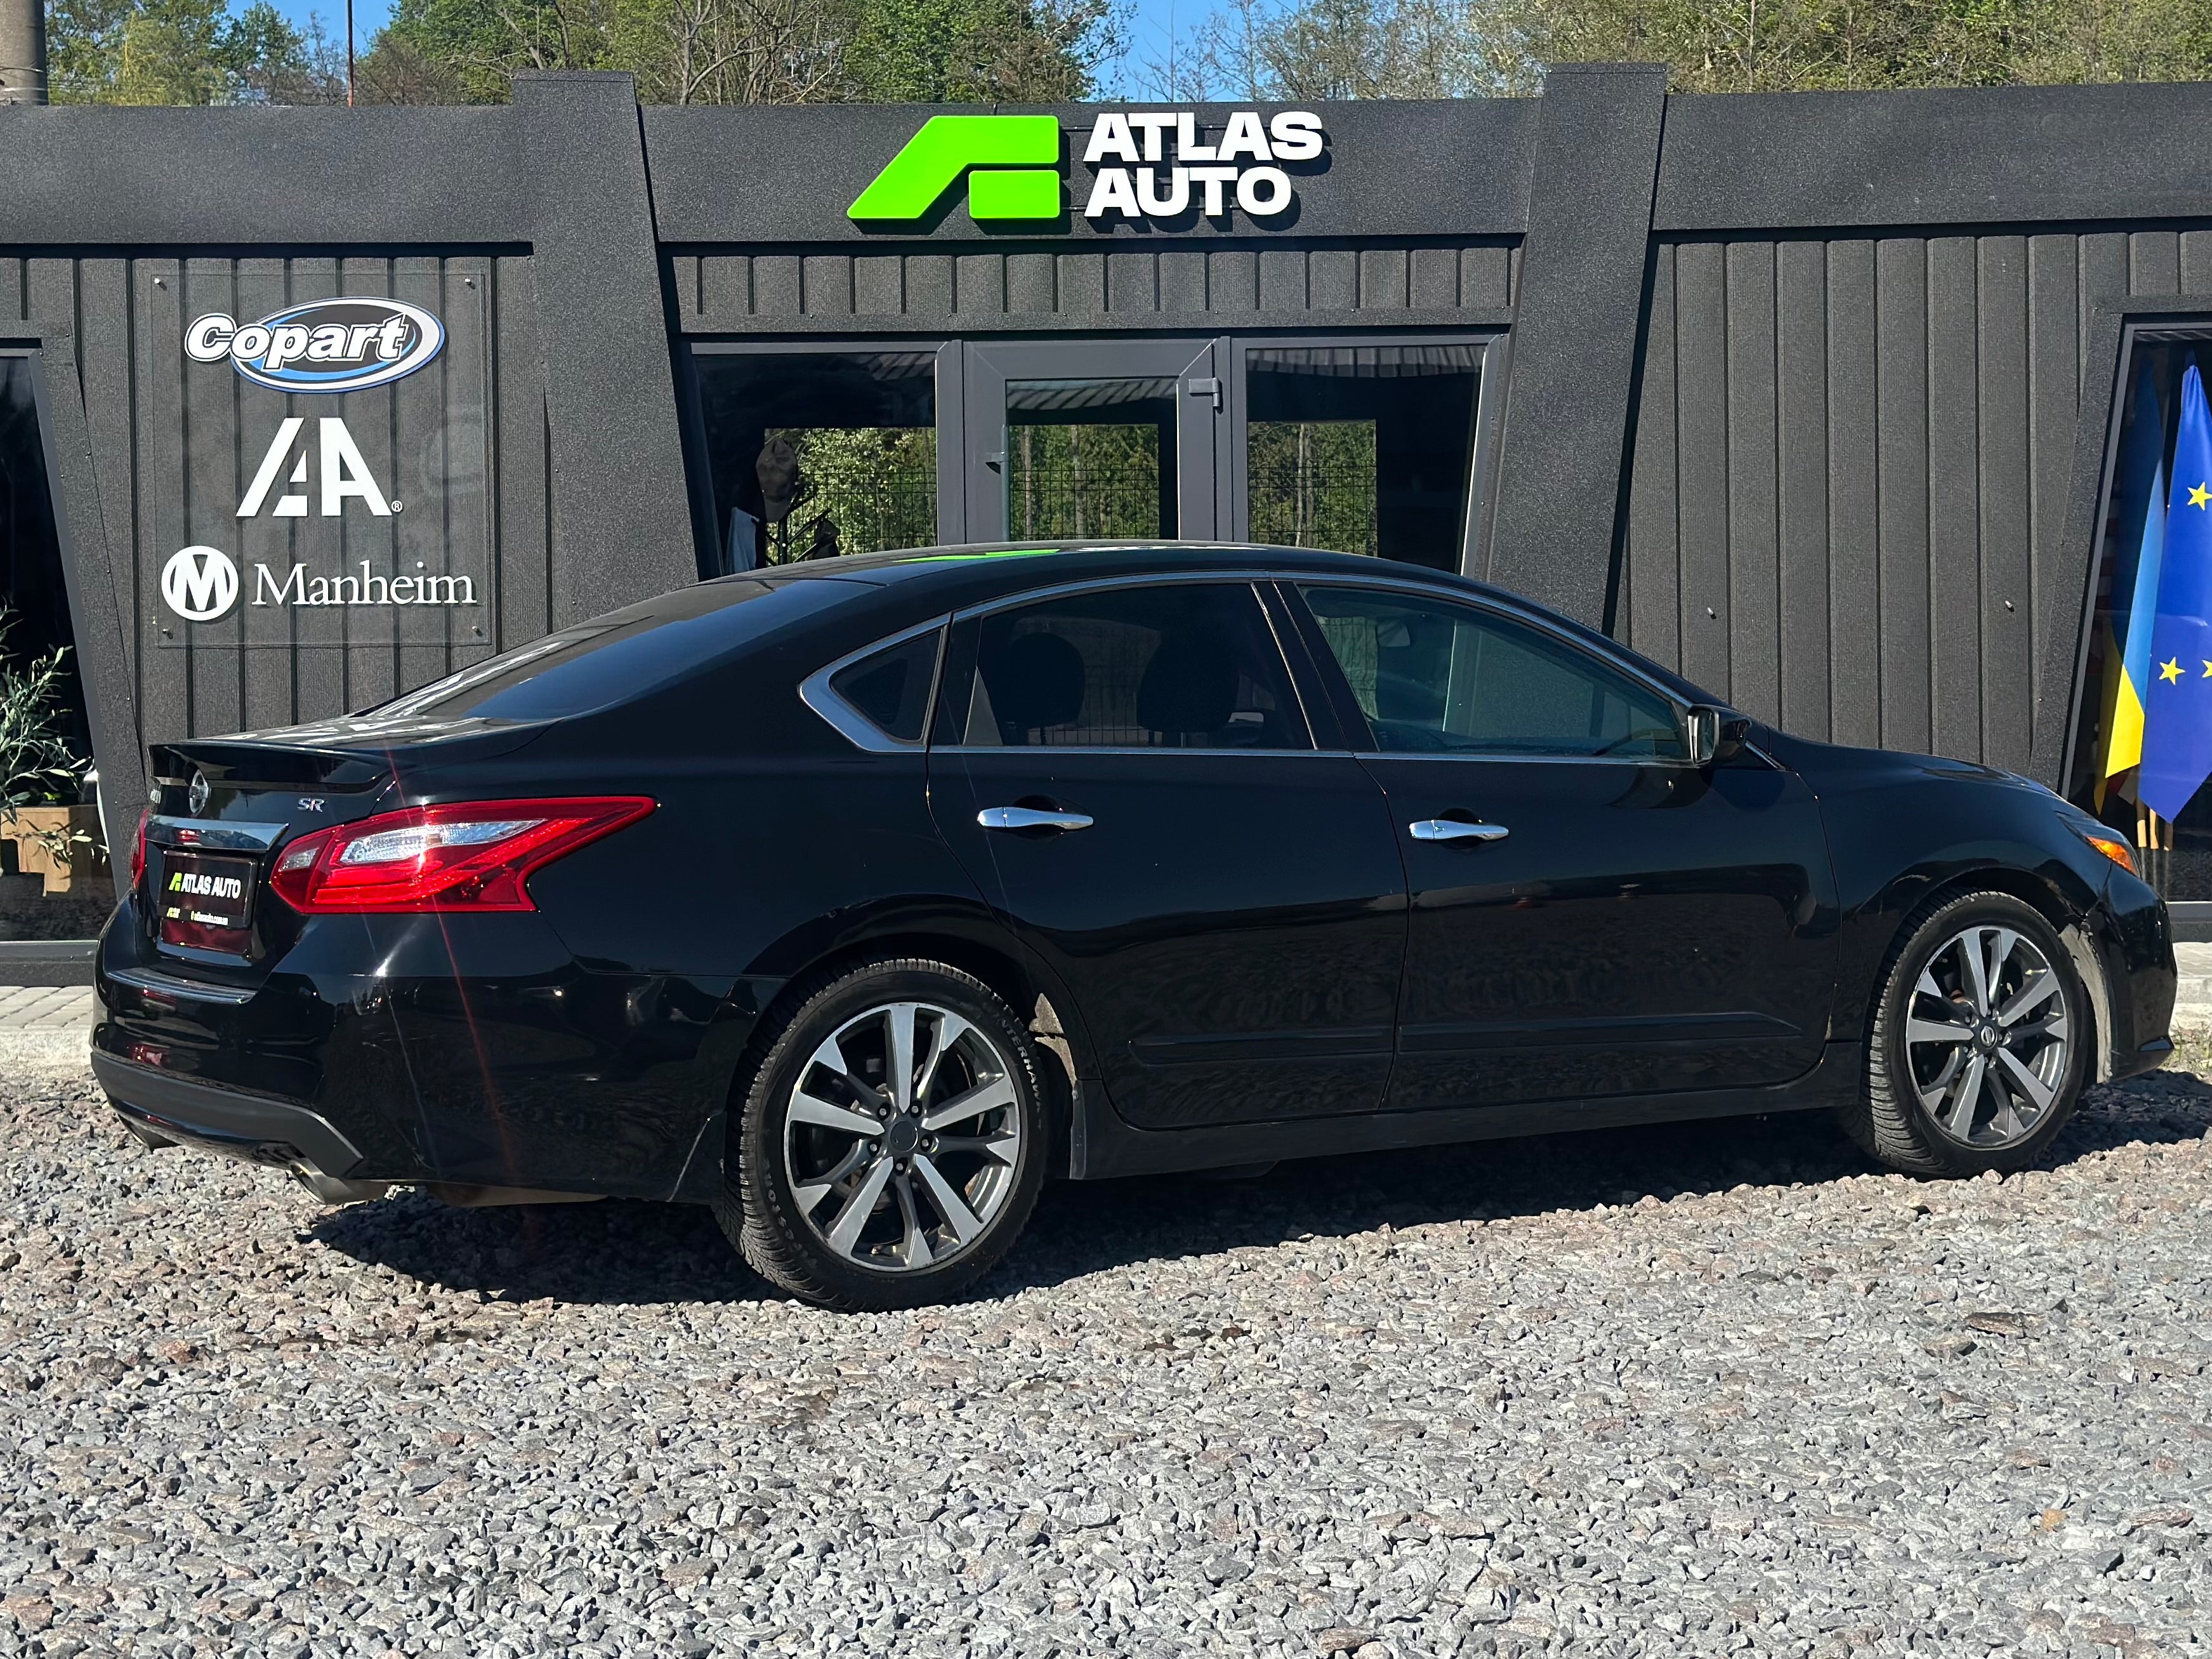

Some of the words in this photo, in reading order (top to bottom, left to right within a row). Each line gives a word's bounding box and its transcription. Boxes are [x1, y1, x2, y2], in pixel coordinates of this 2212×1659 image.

[1083, 111, 1323, 161] ATLAS
[1084, 166, 1292, 217] AUTO
[185, 312, 407, 371] Copart
[251, 560, 477, 605] Manheim
[297, 798, 326, 812] SR
[181, 873, 212, 896] ATLAS
[211, 876, 241, 899] AUTO
